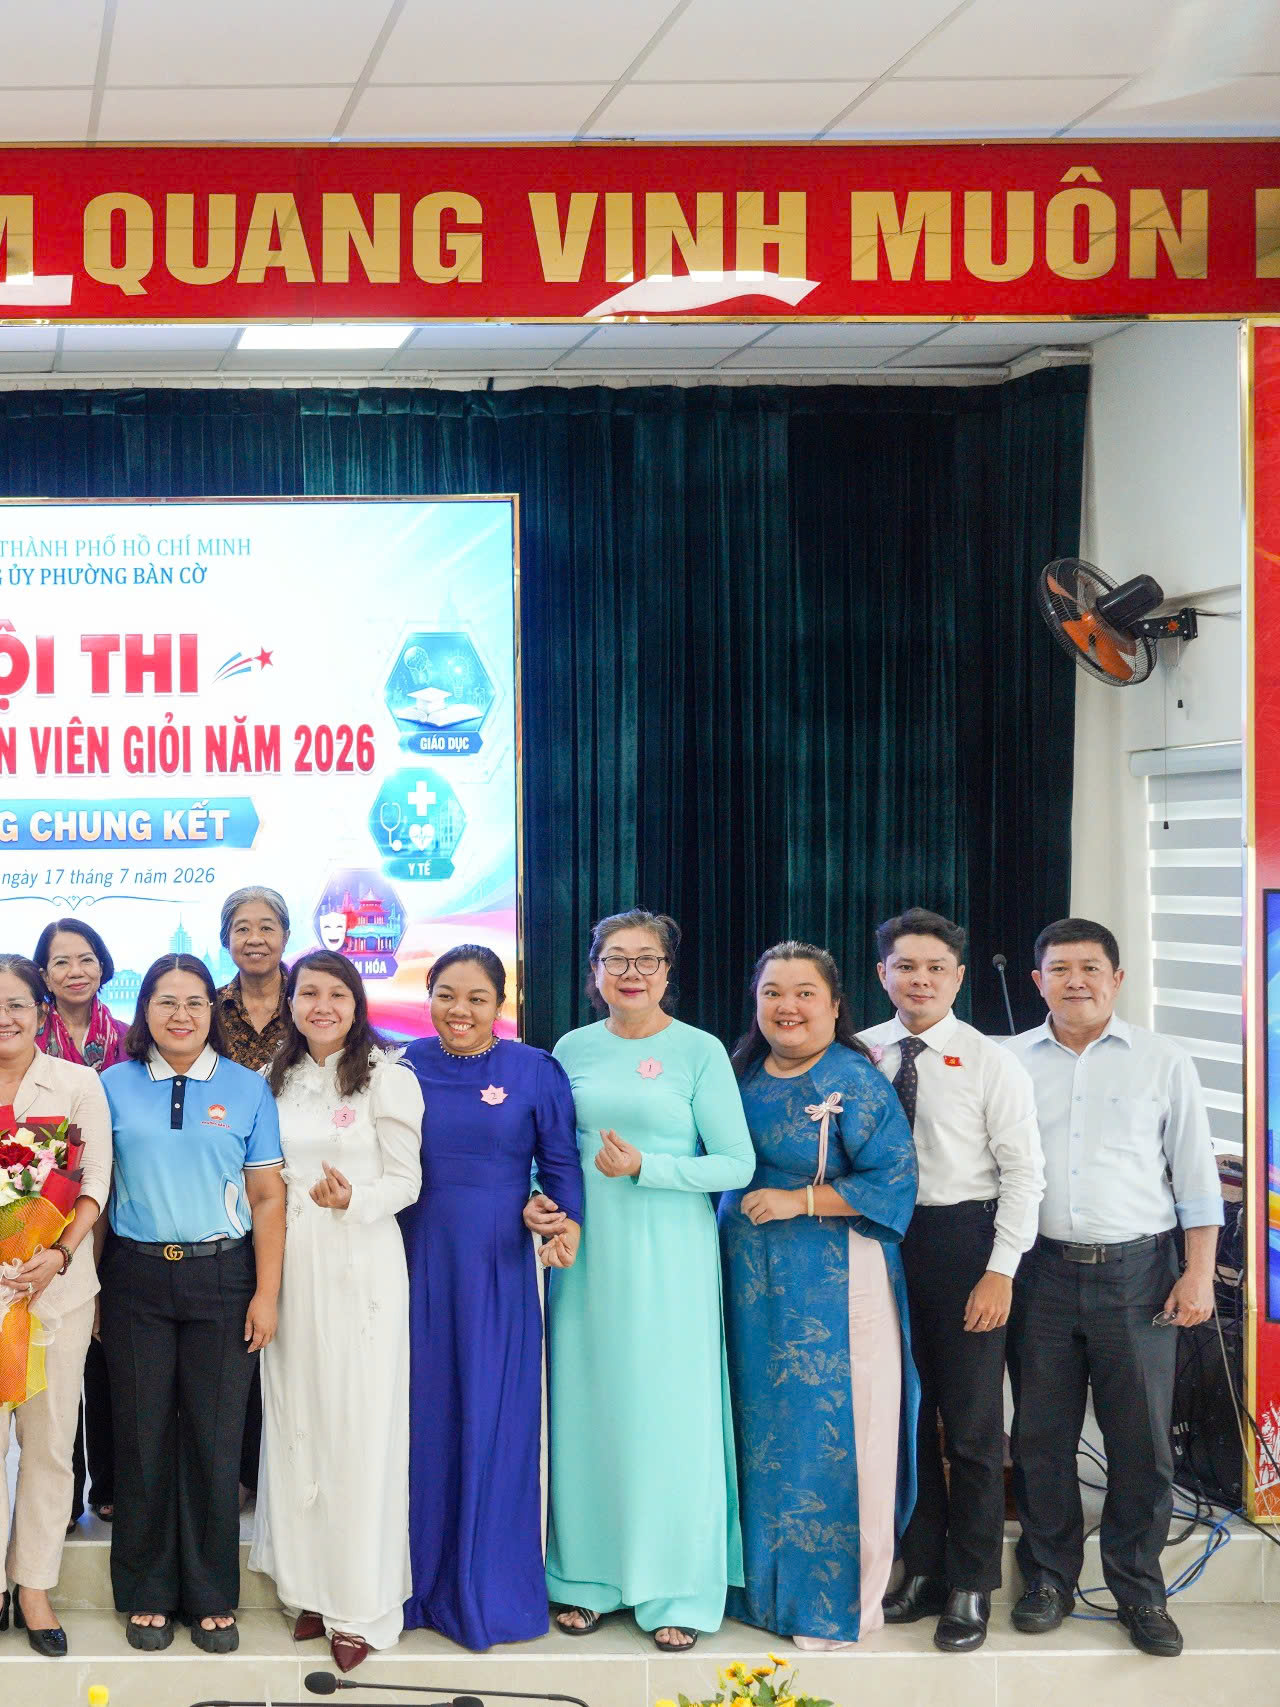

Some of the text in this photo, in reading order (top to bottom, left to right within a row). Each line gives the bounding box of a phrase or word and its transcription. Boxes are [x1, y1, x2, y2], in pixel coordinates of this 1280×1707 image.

[82, 191, 483, 296] QUANG
[528, 191, 808, 284] VINH
[850, 166, 1209, 283] MUÔN
[75, 534, 116, 558] PHỐ
[123, 534, 150, 557] HỒ
[157, 534, 191, 557] CHÍ
[197, 537, 251, 557] MINH
[8, 563, 35, 585] ỦY
[40, 562, 127, 585] PHƯỜNG
[133, 562, 173, 585] BÀN
[180, 561, 208, 585] CỜ
[81, 632, 199, 695] THI
[29, 717, 110, 774] VIÊN
[123, 712, 191, 774] GIỎI
[205, 716, 281, 773] NĂM
[294, 723, 376, 773] 2026
[420, 734, 470, 753] GIÁO DỤC
[29, 809, 153, 842] CHUNG
[163, 800, 231, 841] KẾT
[2, 869, 38, 889] ngày
[44, 869, 65, 885] 17
[70, 868, 114, 888] tháng
[120, 868, 130, 884] 7
[135, 868, 167, 884] năm
[173, 867, 216, 884] 2026
[408, 859, 432, 876] Y TẾ
[365, 959, 387, 974] HÓA
